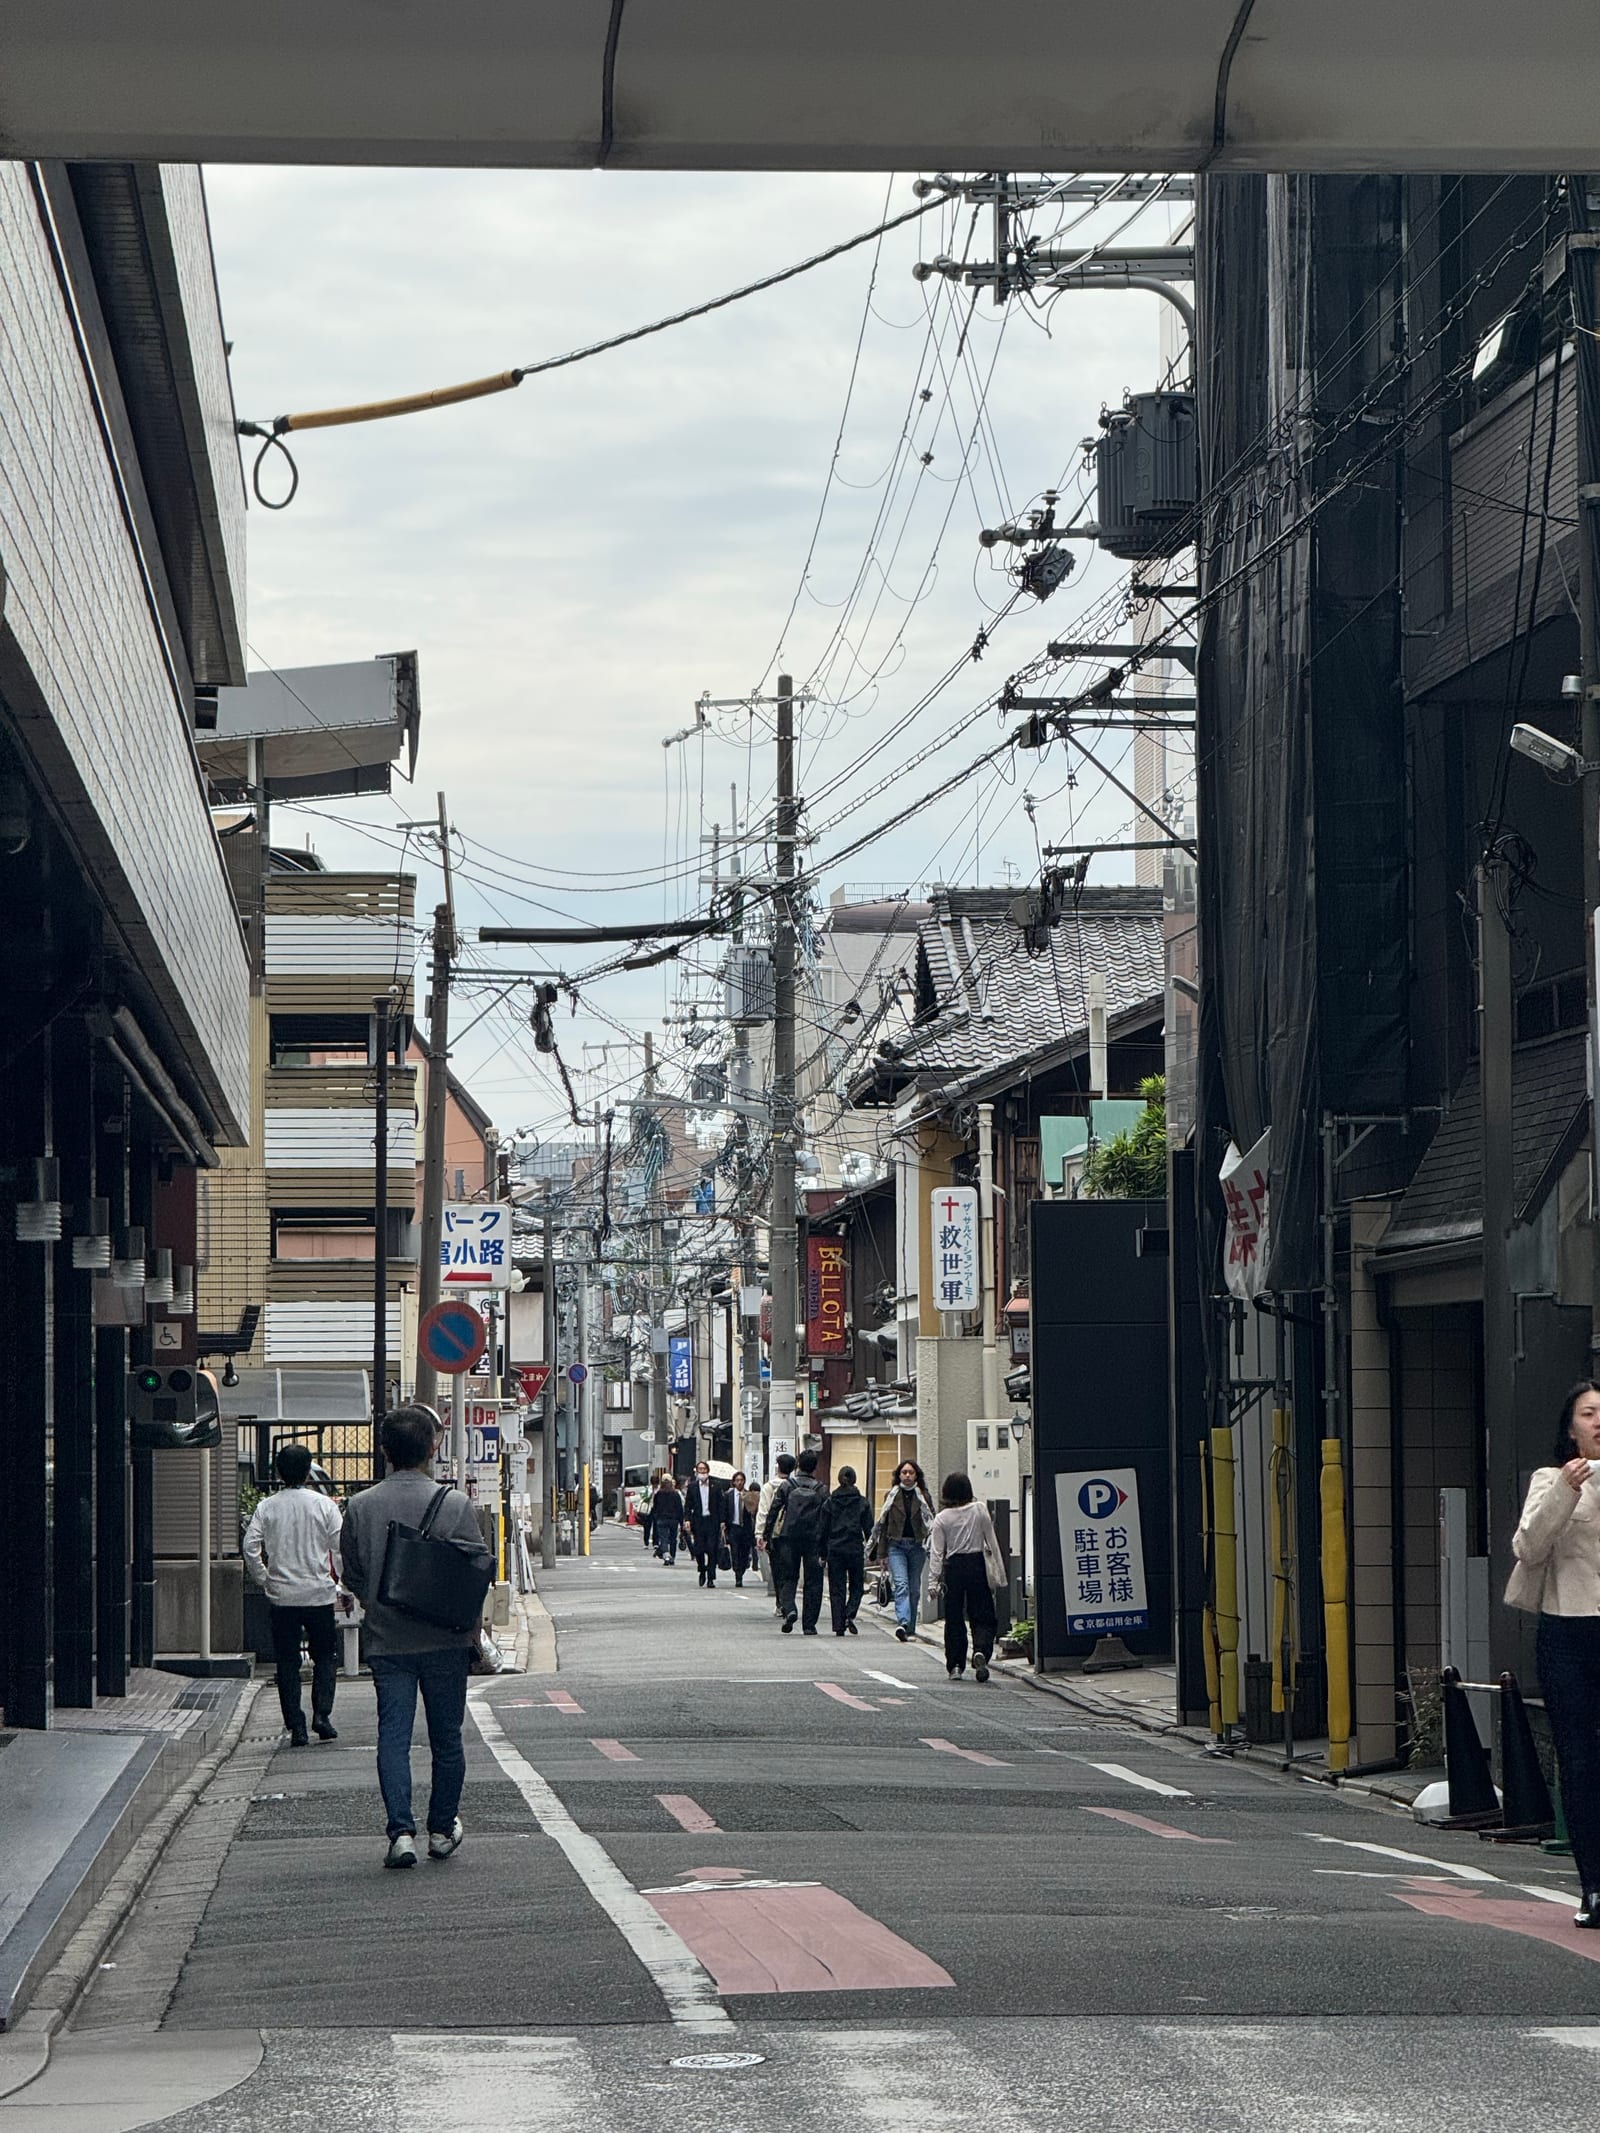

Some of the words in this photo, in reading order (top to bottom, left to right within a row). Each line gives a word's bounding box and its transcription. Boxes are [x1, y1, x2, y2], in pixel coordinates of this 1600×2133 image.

[818, 1247, 843, 1342] BELLOTA
[939, 1225, 963, 1305] 救世軍
[1087, 1484, 1111, 1514] P
[1074, 1528, 1103, 1604] 駐車場
[1105, 1526, 1134, 1603] お客様
[1086, 1615, 1143, 1629] 京都信用金庫
